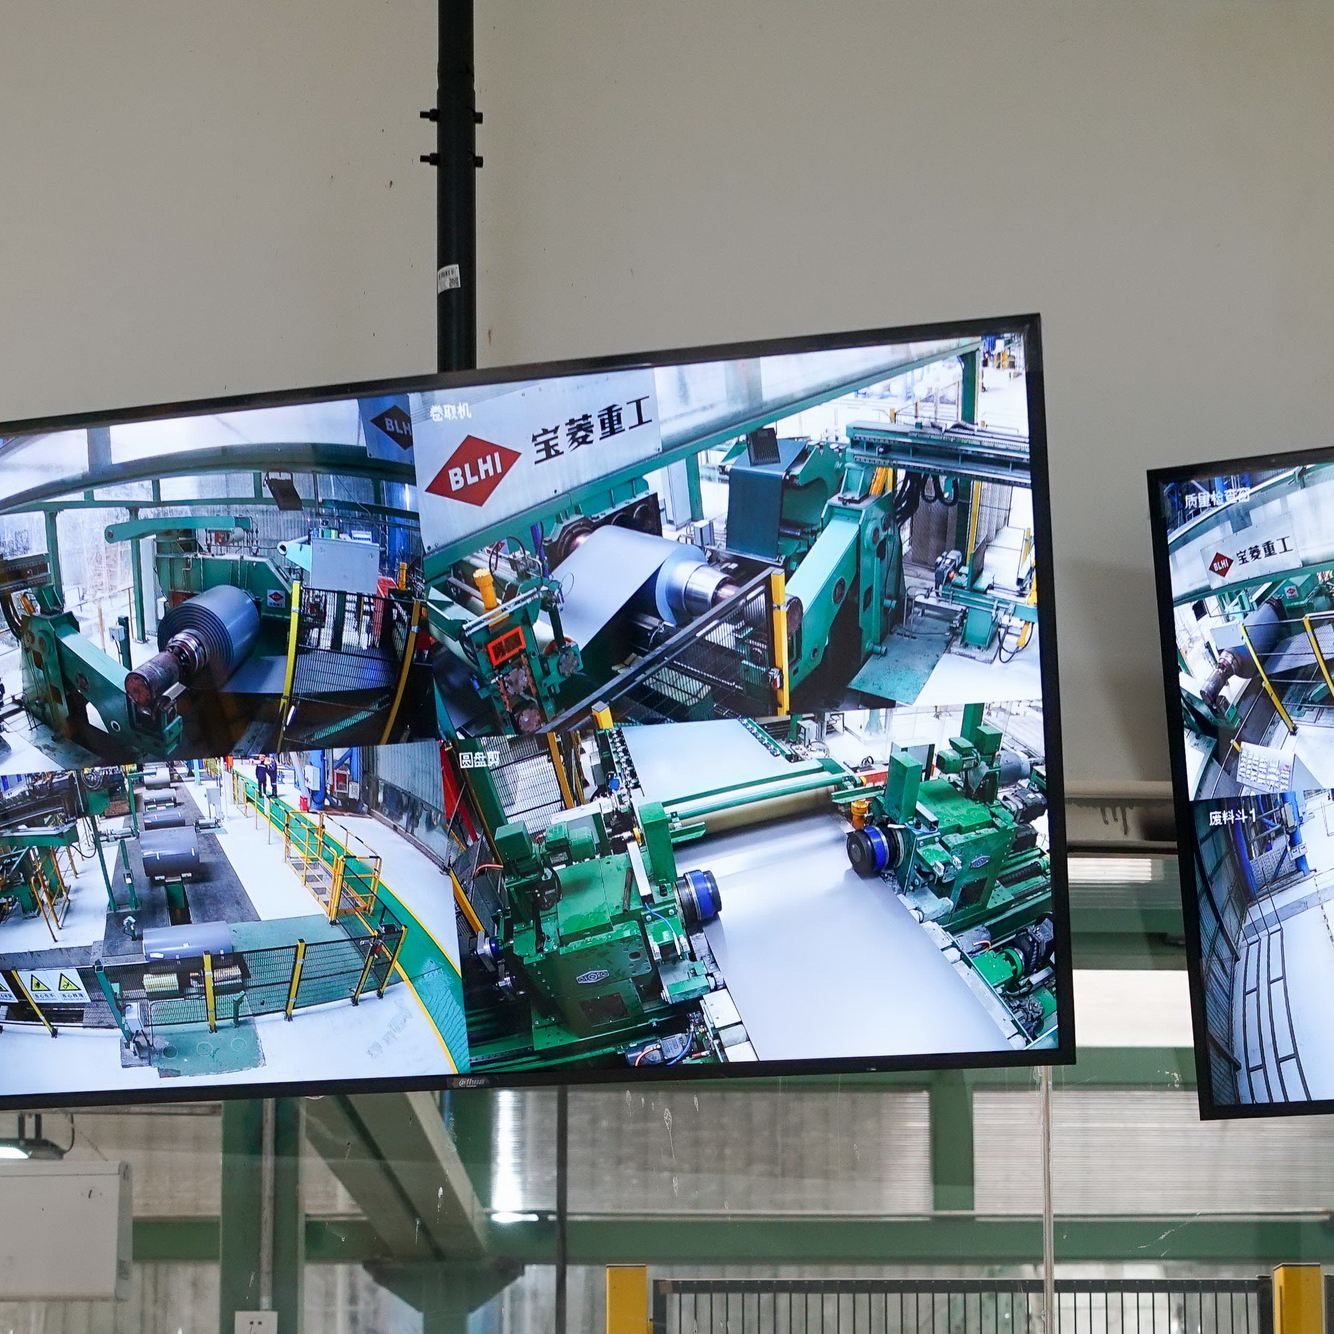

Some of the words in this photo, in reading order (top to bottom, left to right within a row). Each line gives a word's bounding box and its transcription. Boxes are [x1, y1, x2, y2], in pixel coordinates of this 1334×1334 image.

[429, 403, 472, 422] 卷取机
[532, 395, 652, 465] 宝菱重工
[449, 452, 502, 492] BLHI
[1236, 536, 1294, 566] 宝菱重工
[1213, 558, 1229, 573] BLHI
[458, 751, 500, 769] 圆盘剪
[1209, 808, 1257, 826] 废料斗1
